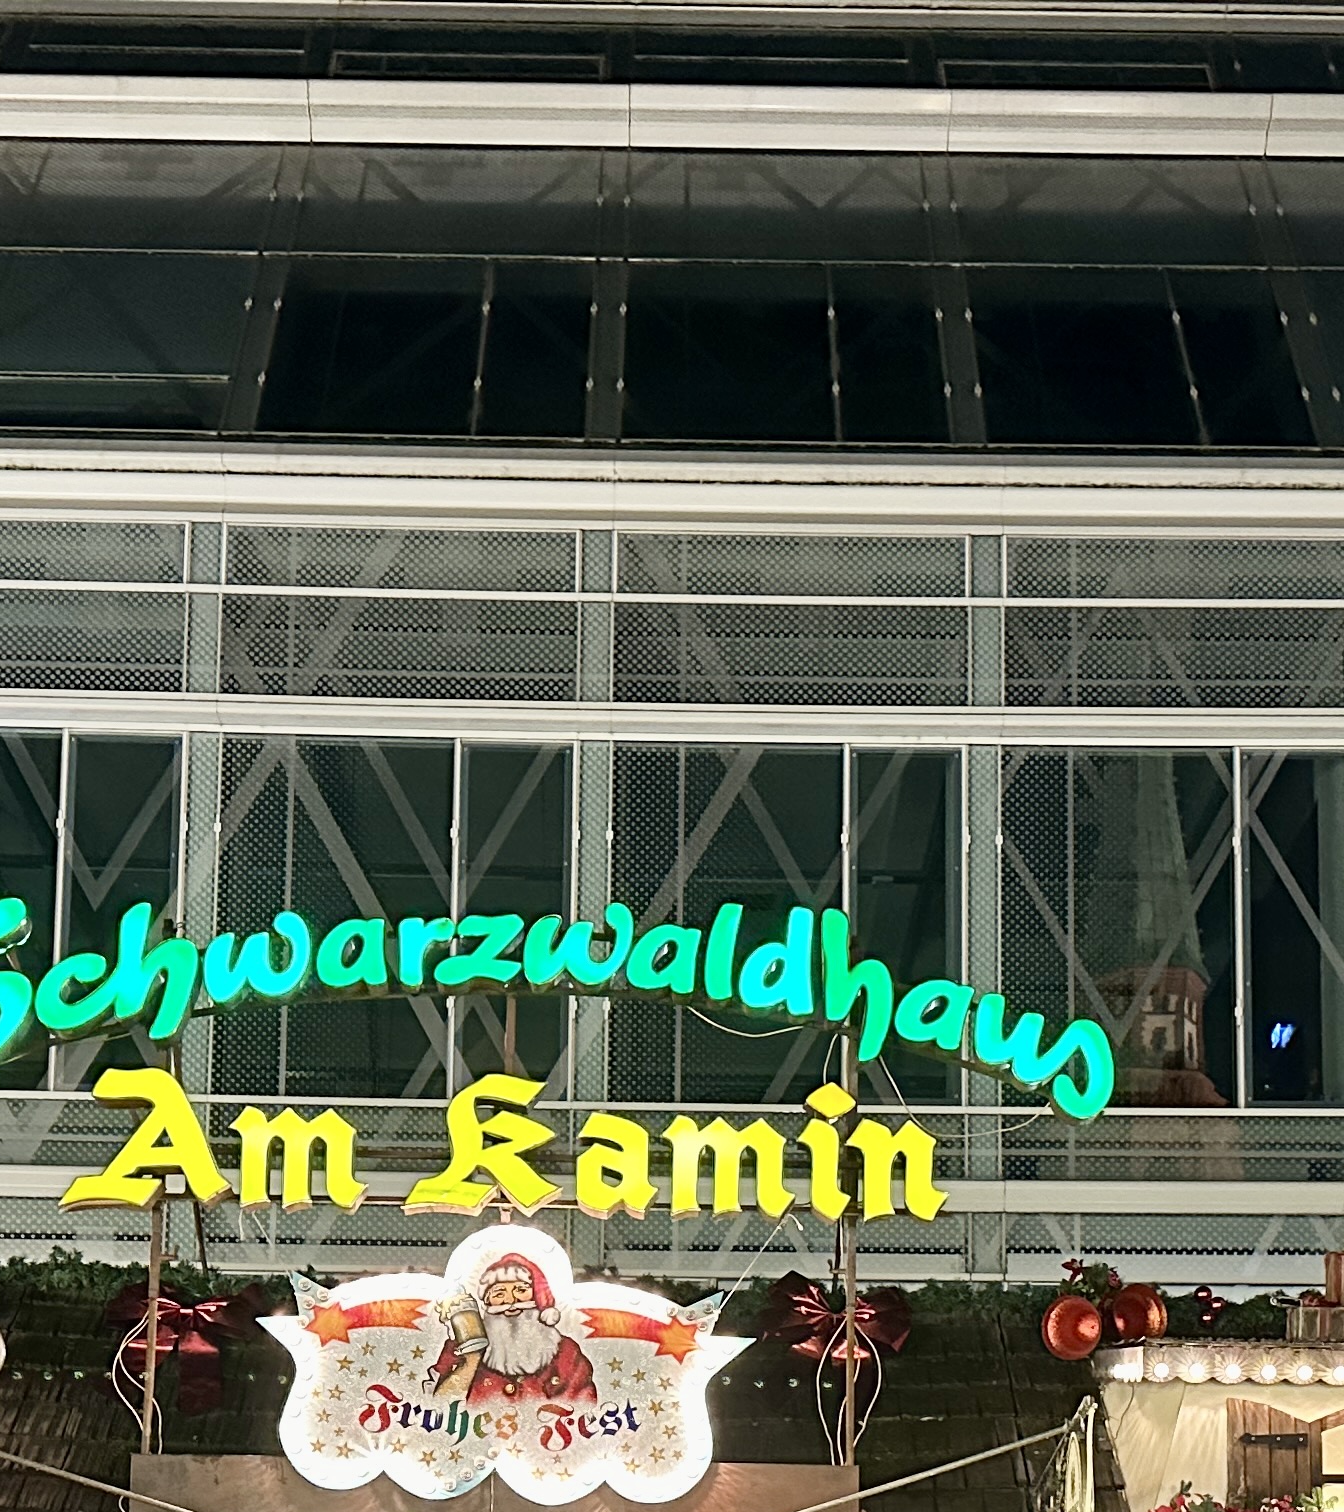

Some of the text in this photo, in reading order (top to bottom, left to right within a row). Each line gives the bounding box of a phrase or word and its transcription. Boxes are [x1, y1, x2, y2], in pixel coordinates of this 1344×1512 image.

[60, 1068, 950, 1222] Am Kamin
[358, 1384, 642, 1451] Frohes Fest
